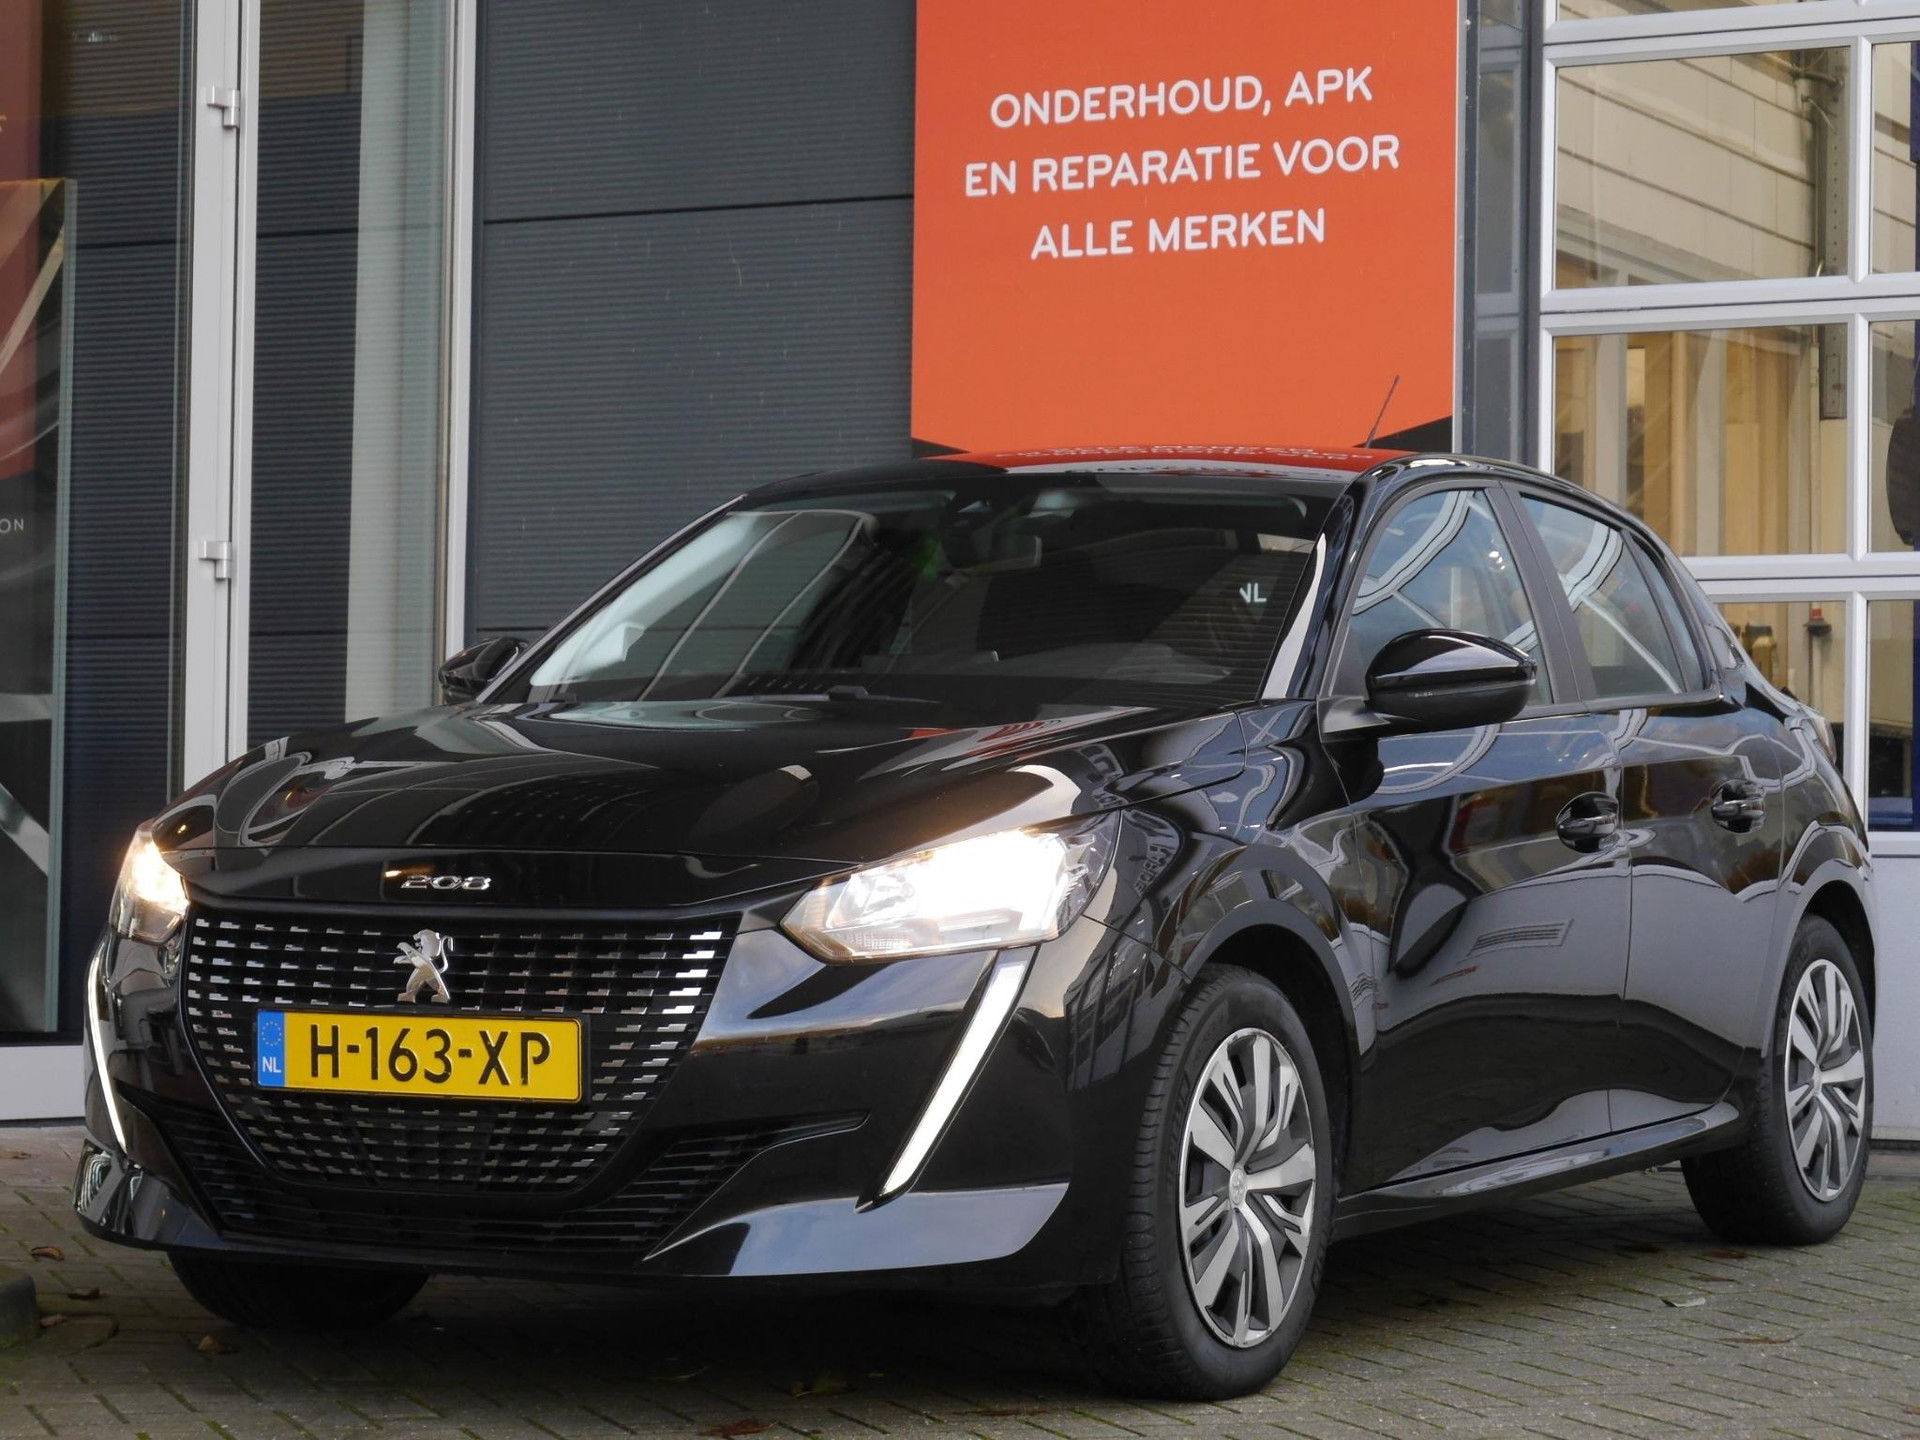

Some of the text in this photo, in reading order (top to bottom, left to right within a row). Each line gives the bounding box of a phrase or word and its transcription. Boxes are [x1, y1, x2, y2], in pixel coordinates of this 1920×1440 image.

[990, 66, 1373, 128] ONDERHOUD, APK
[965, 134, 1400, 197] EN REPARATIE VOOR
[1030, 207, 1325, 260] ALLE MERKEN
[400, 875, 492, 890] 208
[261, 1055, 282, 1074] NL
[310, 1023, 551, 1086] H-163-XP
